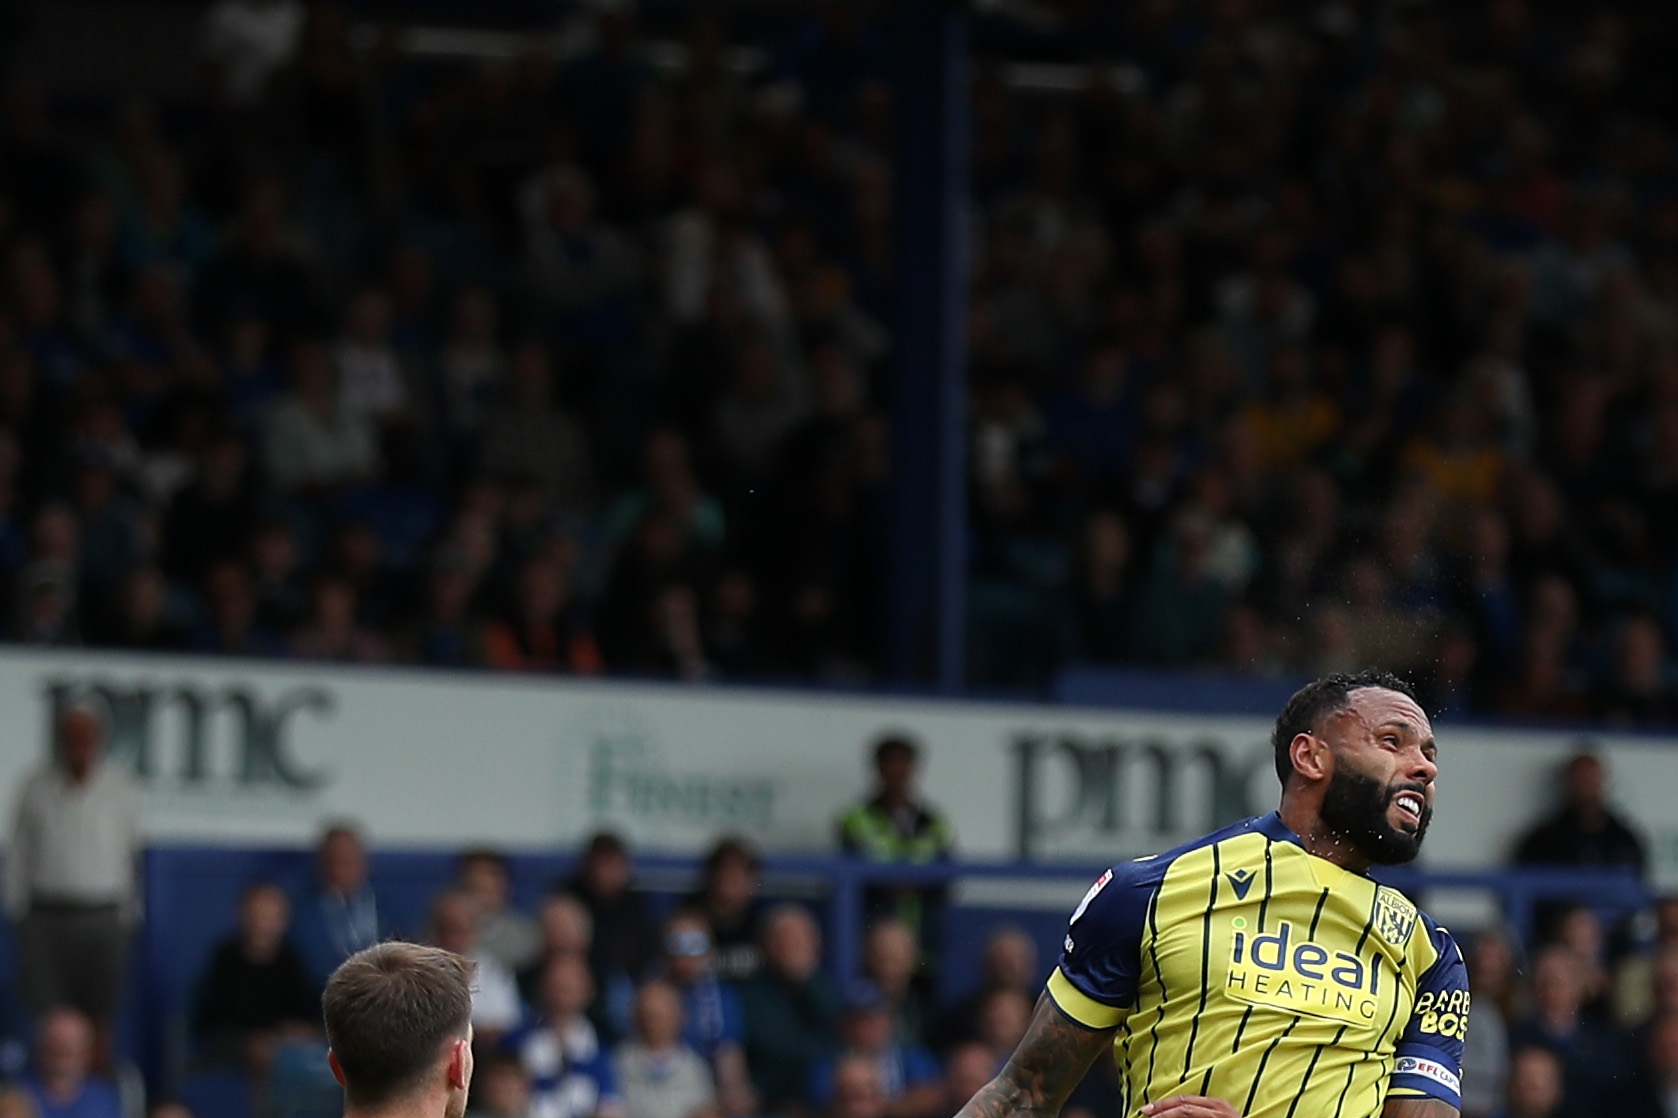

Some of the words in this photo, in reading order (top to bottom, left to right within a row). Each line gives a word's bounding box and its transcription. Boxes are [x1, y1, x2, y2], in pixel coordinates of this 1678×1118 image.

[1232, 915, 1384, 996] ideal
[1228, 969, 1375, 1019] HEATING
[1418, 1062, 1438, 1077] EFL
